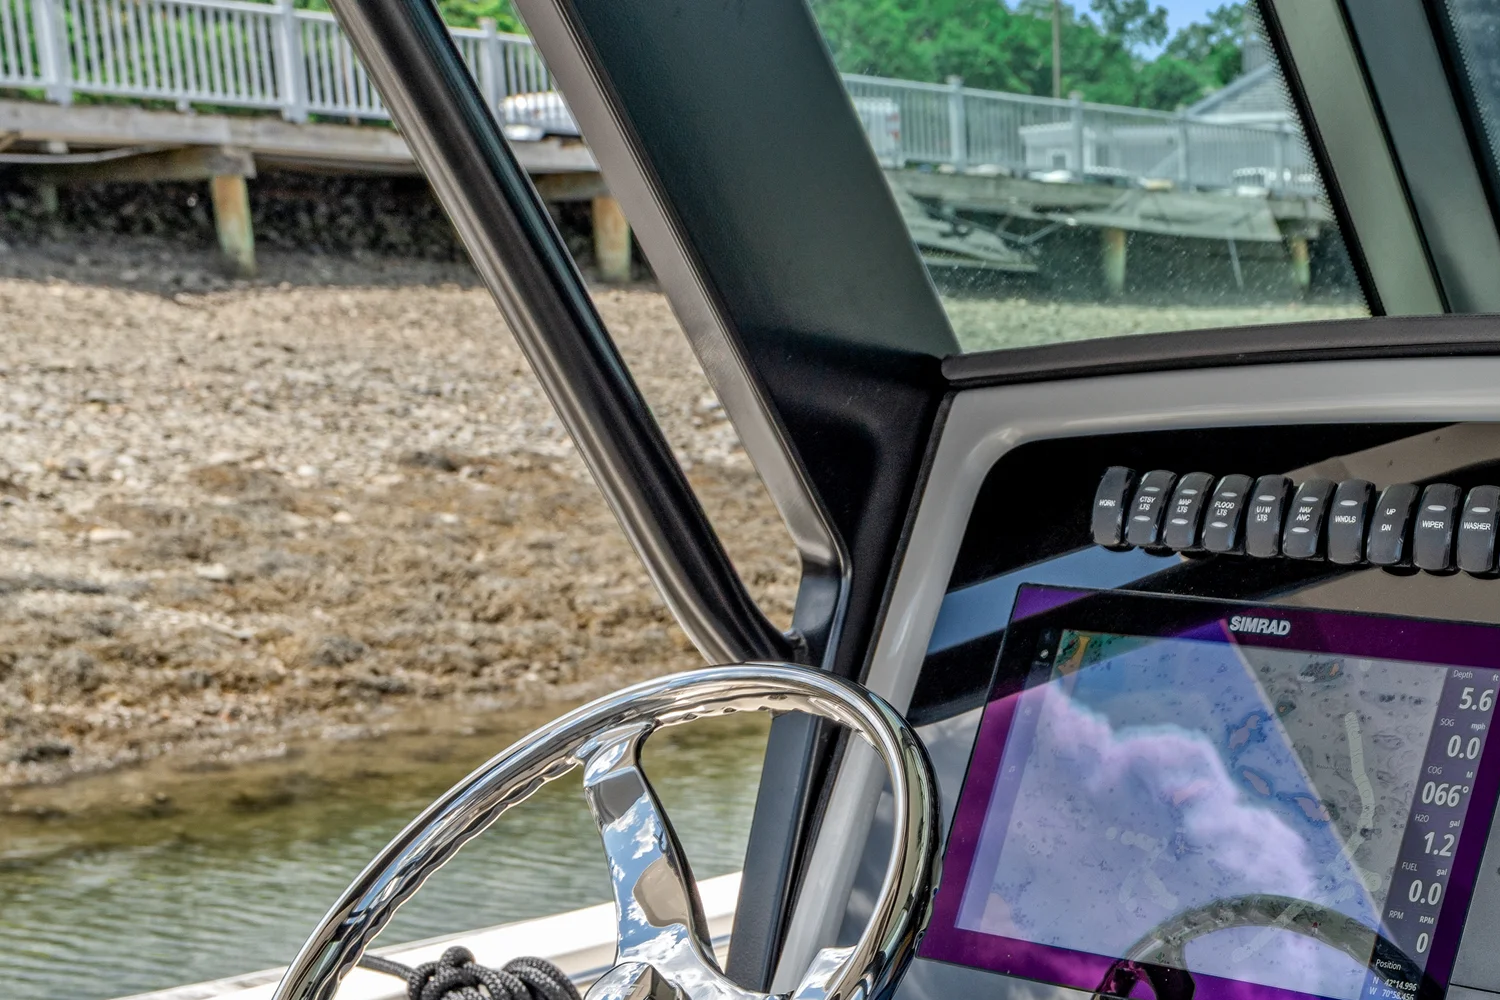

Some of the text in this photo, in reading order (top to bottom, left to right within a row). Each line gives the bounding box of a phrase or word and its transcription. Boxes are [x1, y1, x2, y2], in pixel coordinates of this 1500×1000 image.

[1139, 496, 1156, 504] CTSY
[1214, 501, 1235, 510] FLOOD
[1139, 503, 1150, 511] LTS
[1216, 508, 1228, 516] LTS
[1299, 506, 1313, 514] NAV
[1386, 508, 1396, 516] UP
[1256, 514, 1268, 522] LTS
[1296, 514, 1311, 522] ANC
[1335, 515, 1357, 524] WNDLS
[1381, 523, 1392, 531] DN
[1422, 520, 1445, 529] WIPER
[1463, 522, 1491, 531] WASHER
[1230, 616, 1291, 636] SIMRAD
[1453, 670, 1500, 682] Depth ft
[1459, 687, 1494, 711] 5.6
[1440, 718, 1486, 731] SOG mph
[1447, 735, 1480, 760] 0.0
[1427, 766, 1474, 778] COG M
[1422, 782, 1469, 807] 066°
[1414, 814, 1460, 828] H2O gal
[1424, 832, 1455, 856] 1.2
[1402, 862, 1448, 876] FUEL gal
[1408, 880, 1442, 906] 0.0
[1388, 910, 1434, 924] RPM RPM
[1416, 932, 1428, 953] 0
[1376, 959, 1402, 970] Position
[1370, 986, 1378, 995] W
